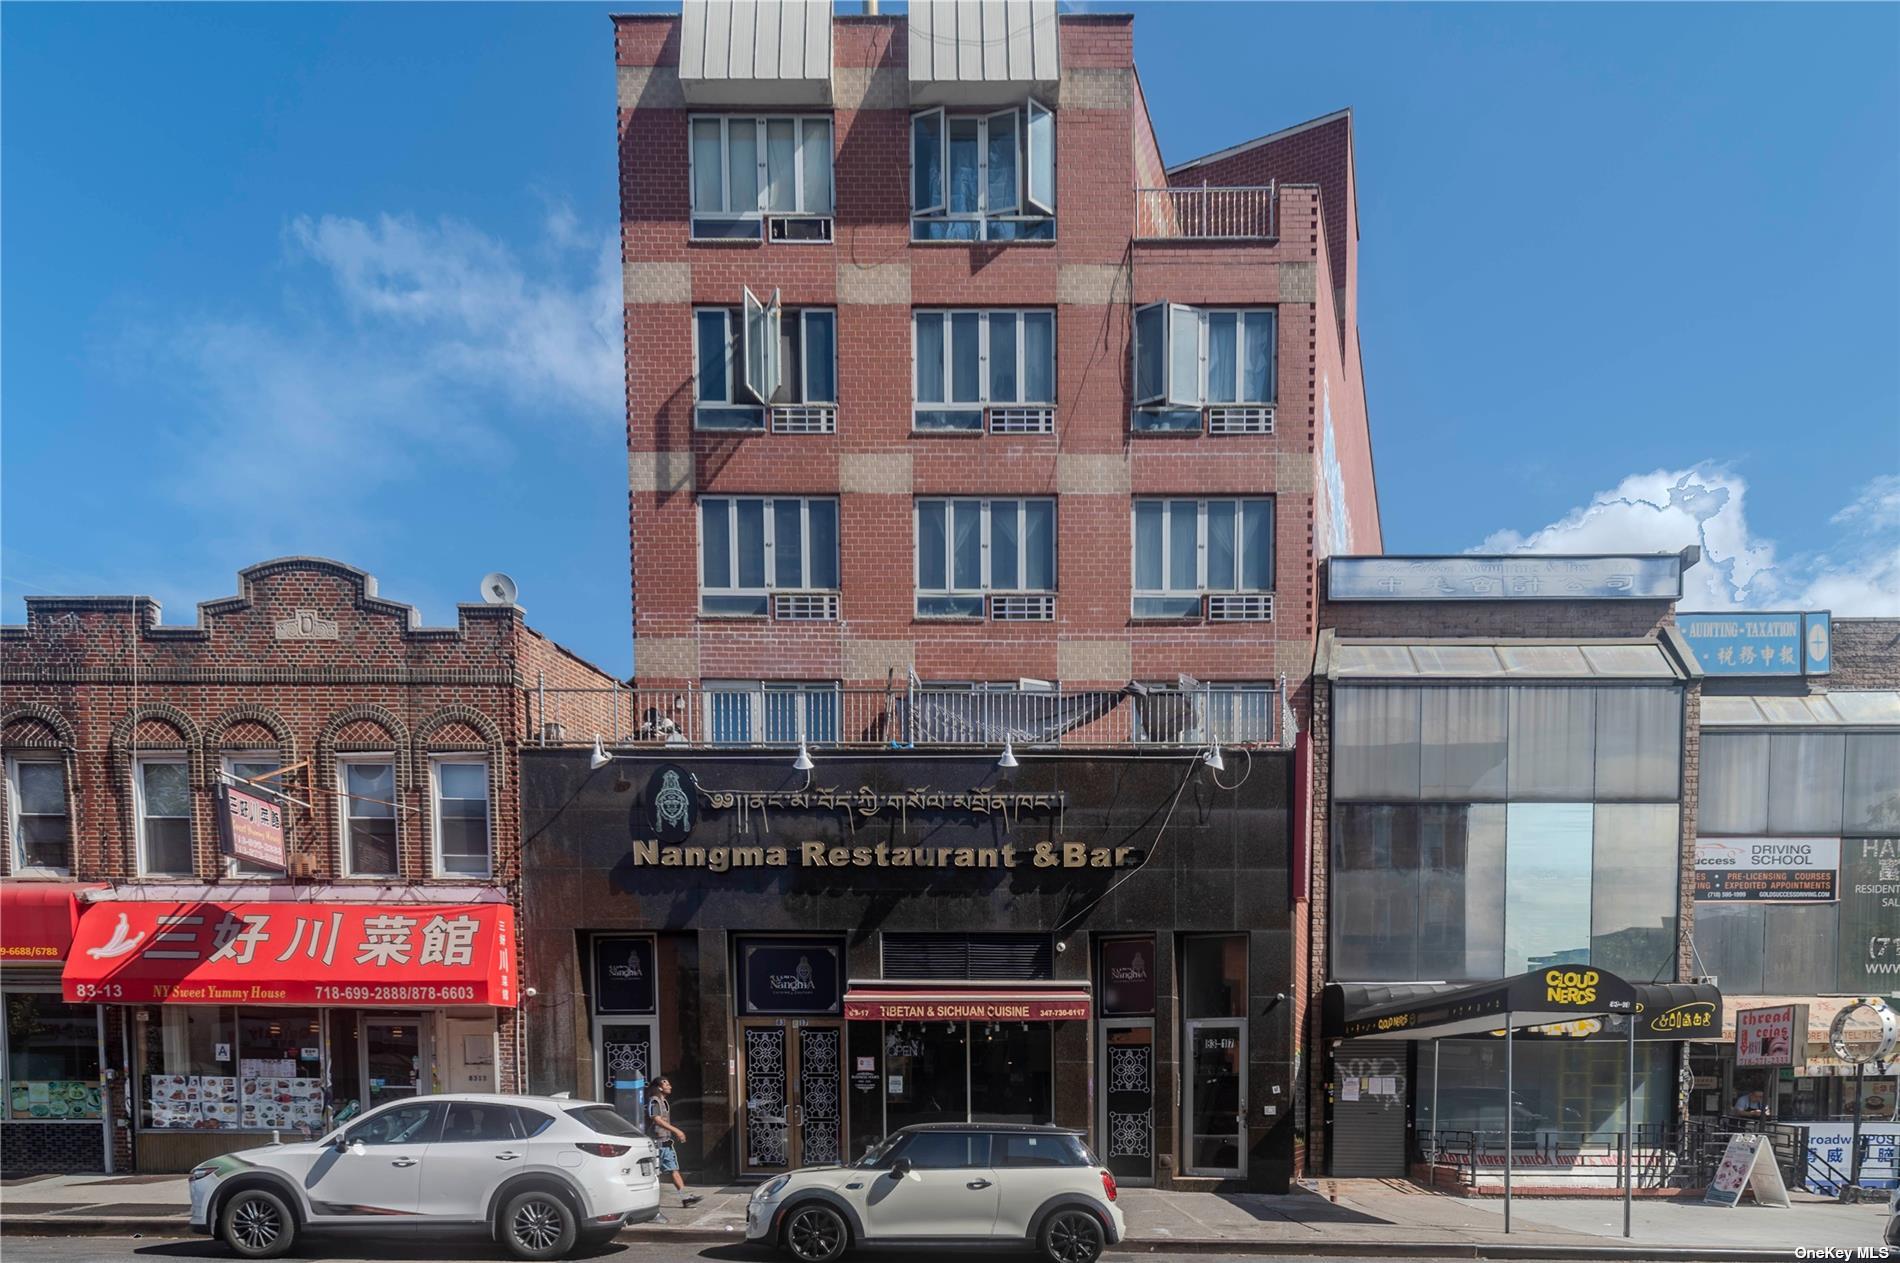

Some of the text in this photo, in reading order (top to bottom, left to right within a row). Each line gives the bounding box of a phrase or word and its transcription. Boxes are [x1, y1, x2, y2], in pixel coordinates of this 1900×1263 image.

[632, 839, 788, 873] Nangma
[801, 841, 1018, 868] Restaurant
[1751, 844, 1812, 855] DRIVING
[1695, 854, 1814, 865] uccess SCHOOL
[1727, 872, 1787, 881] PRE-LICENSING
[1794, 872, 1832, 881] COURSES
[1724, 881, 1767, 890] EXPEDITED
[1770, 881, 1831, 890] APPOINTMENTS
[142, 911, 481, 967] 三好川菜館
[1545, 969, 1599, 988] CLOUD
[76, 984, 475, 1002] 83-13 NY Sweet Yummy House 718-699-2888/878-6603
[1546, 987, 1597, 1005] NERDS
[880, 1006, 925, 1017] TIBETAN
[926, 1006, 935, 1017] &
[937, 1006, 985, 1017] SICHUAN
[987, 1005, 1030, 1017] CUISINE
[1742, 1007, 1792, 1026] thread
[217, 1045, 228, 1057] A
[887, 1044, 919, 1057] OPEN
